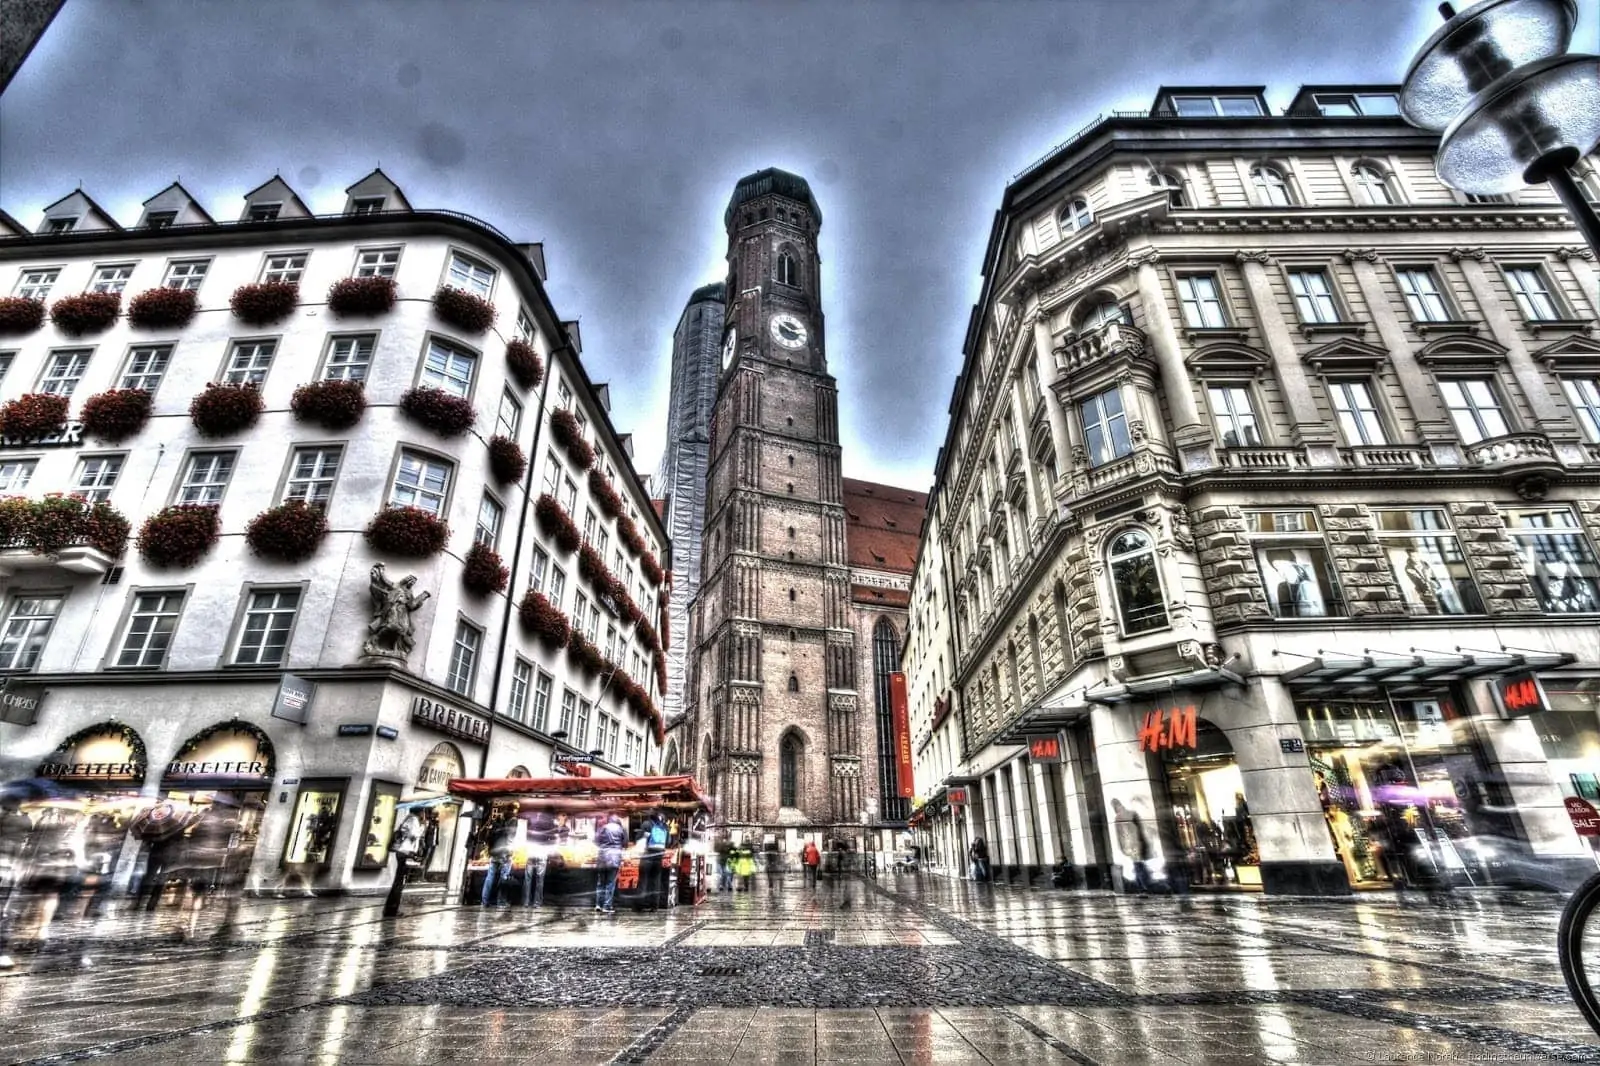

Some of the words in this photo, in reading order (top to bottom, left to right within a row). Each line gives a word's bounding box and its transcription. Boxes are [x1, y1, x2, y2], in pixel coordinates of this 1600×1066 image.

[420, 698, 489, 741] BREITER
[1138, 705, 1197, 753] H&M
[1032, 739, 1058, 758] H&M
[43, 762, 132, 776] BREITER
[169, 761, 263, 776] BREITER
[1574, 819, 1597, 828] SALE
